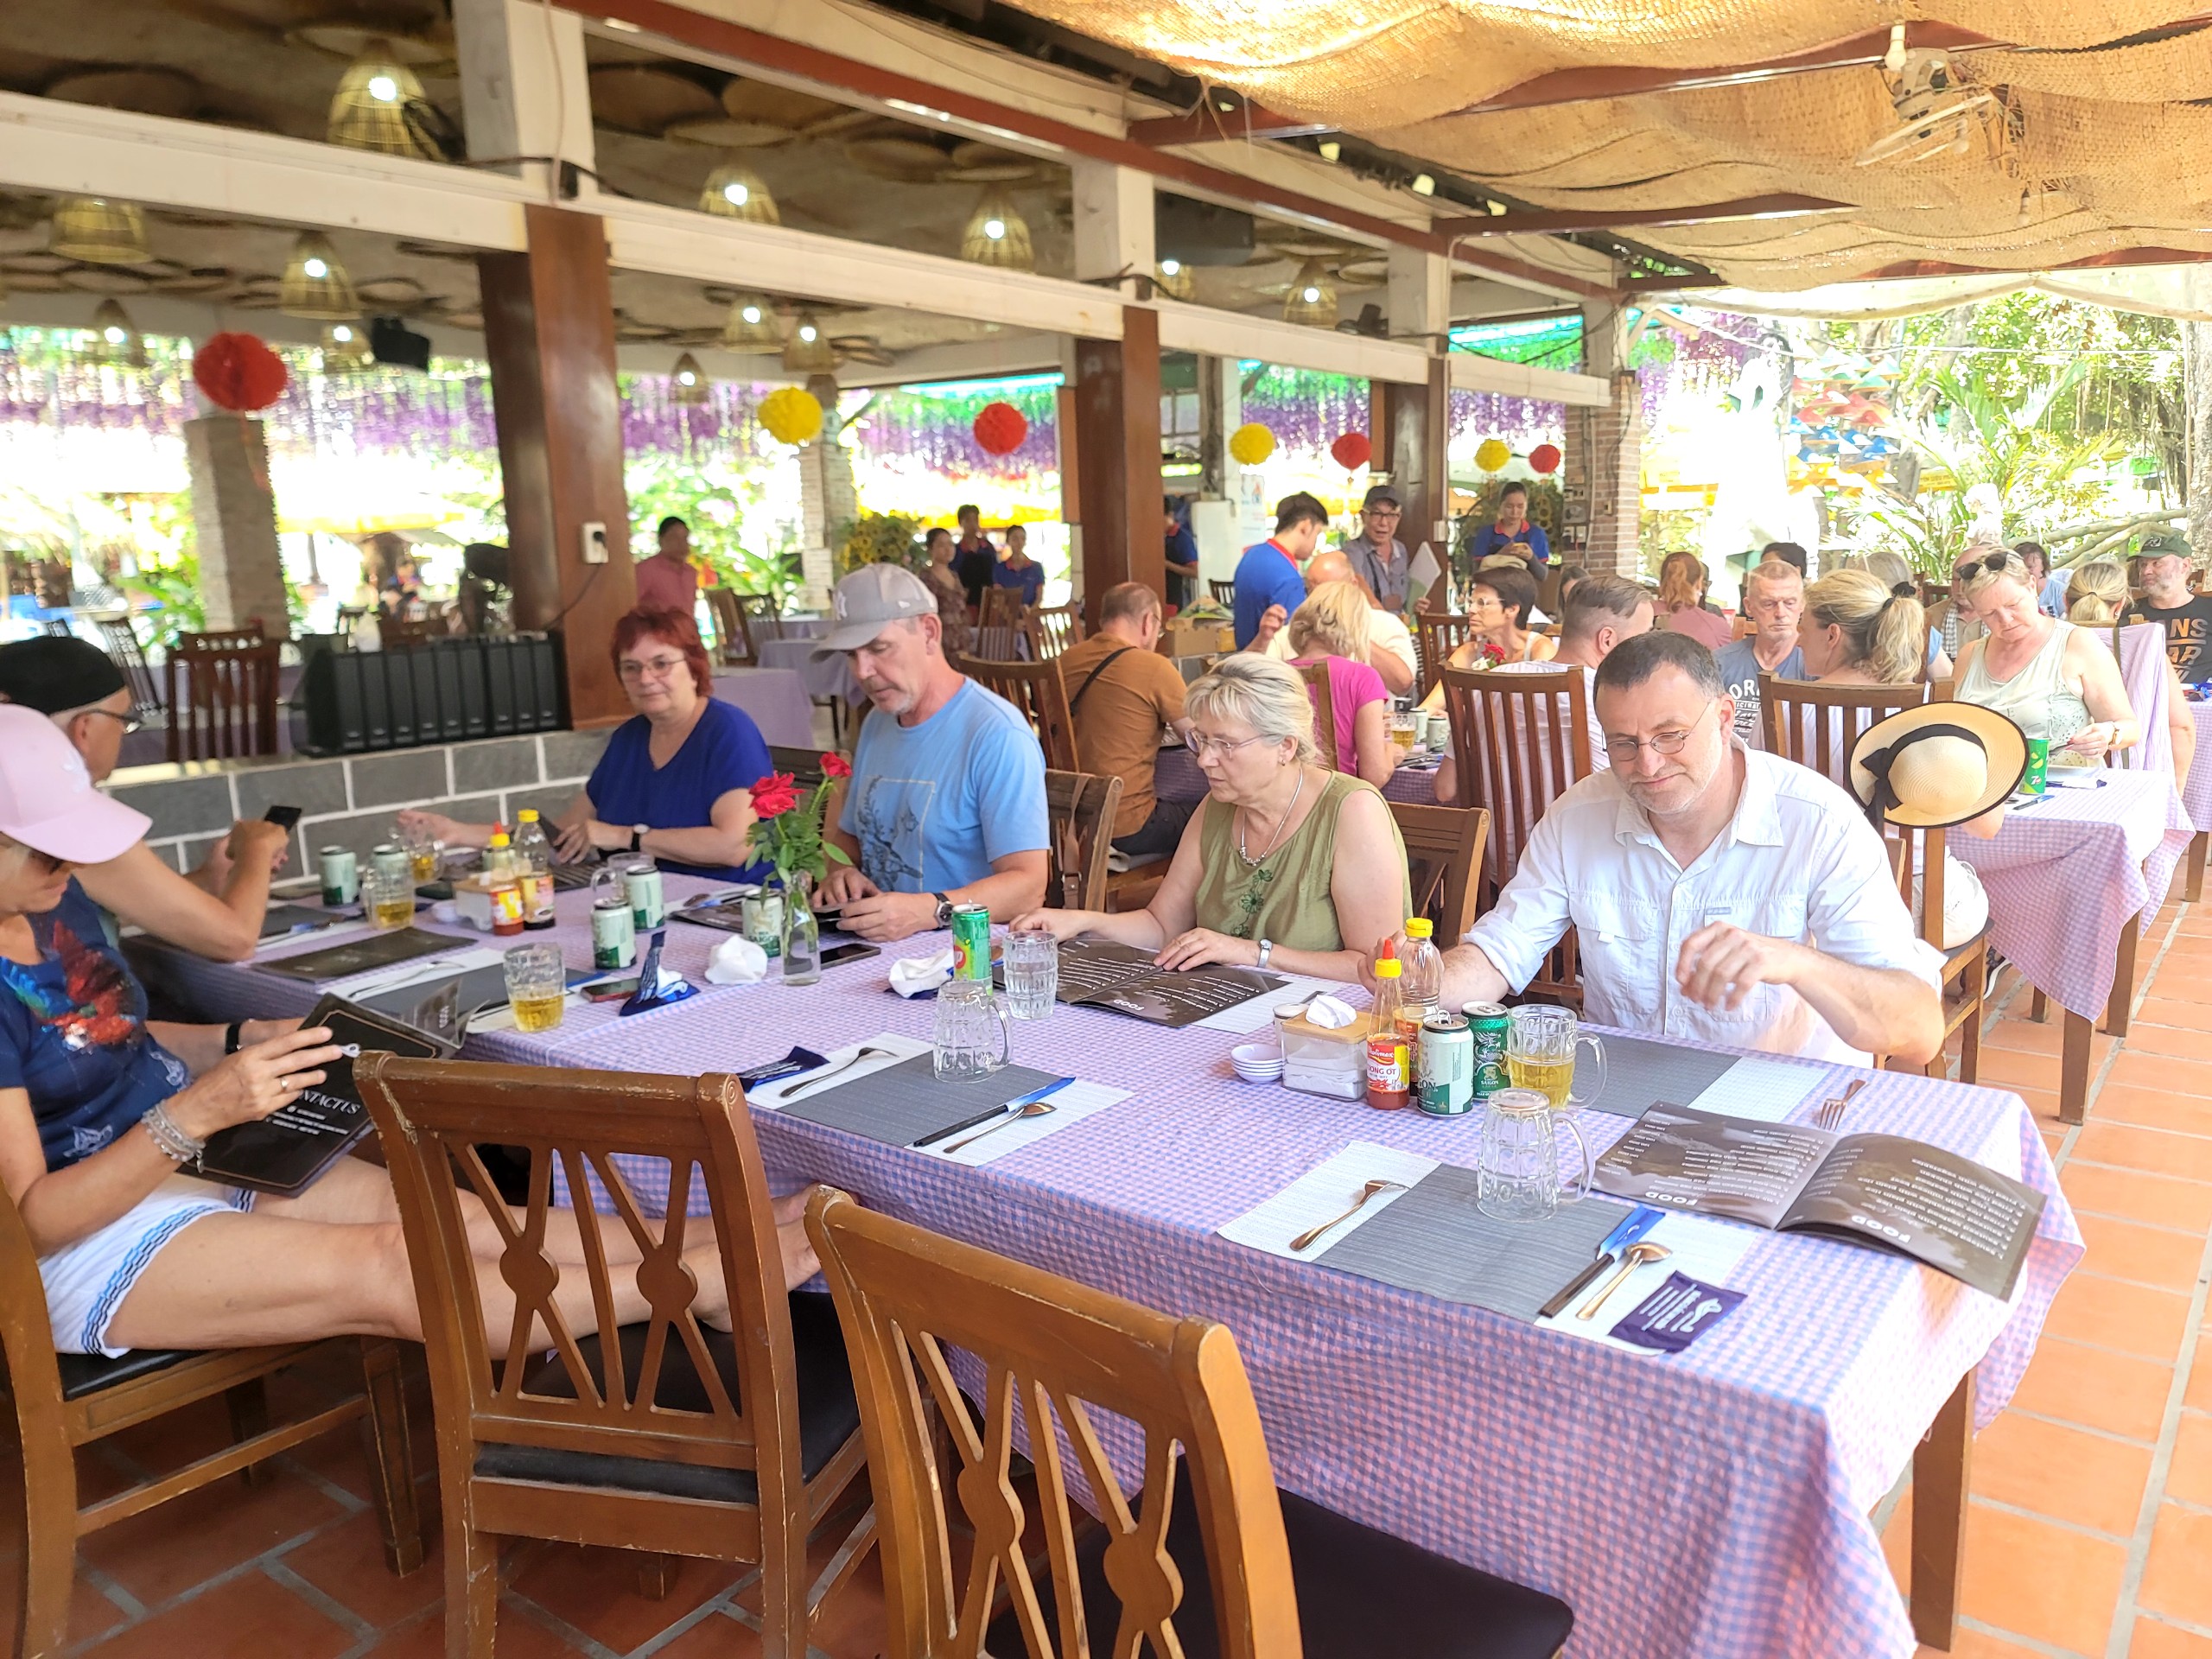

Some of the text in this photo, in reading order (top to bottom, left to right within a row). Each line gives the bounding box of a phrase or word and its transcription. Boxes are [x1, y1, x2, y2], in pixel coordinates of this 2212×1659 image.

[1113, 999, 1145, 1011] FOOD
[1644, 1190, 1699, 1206] FOOD
[1851, 1215, 1911, 1243] FOOD
